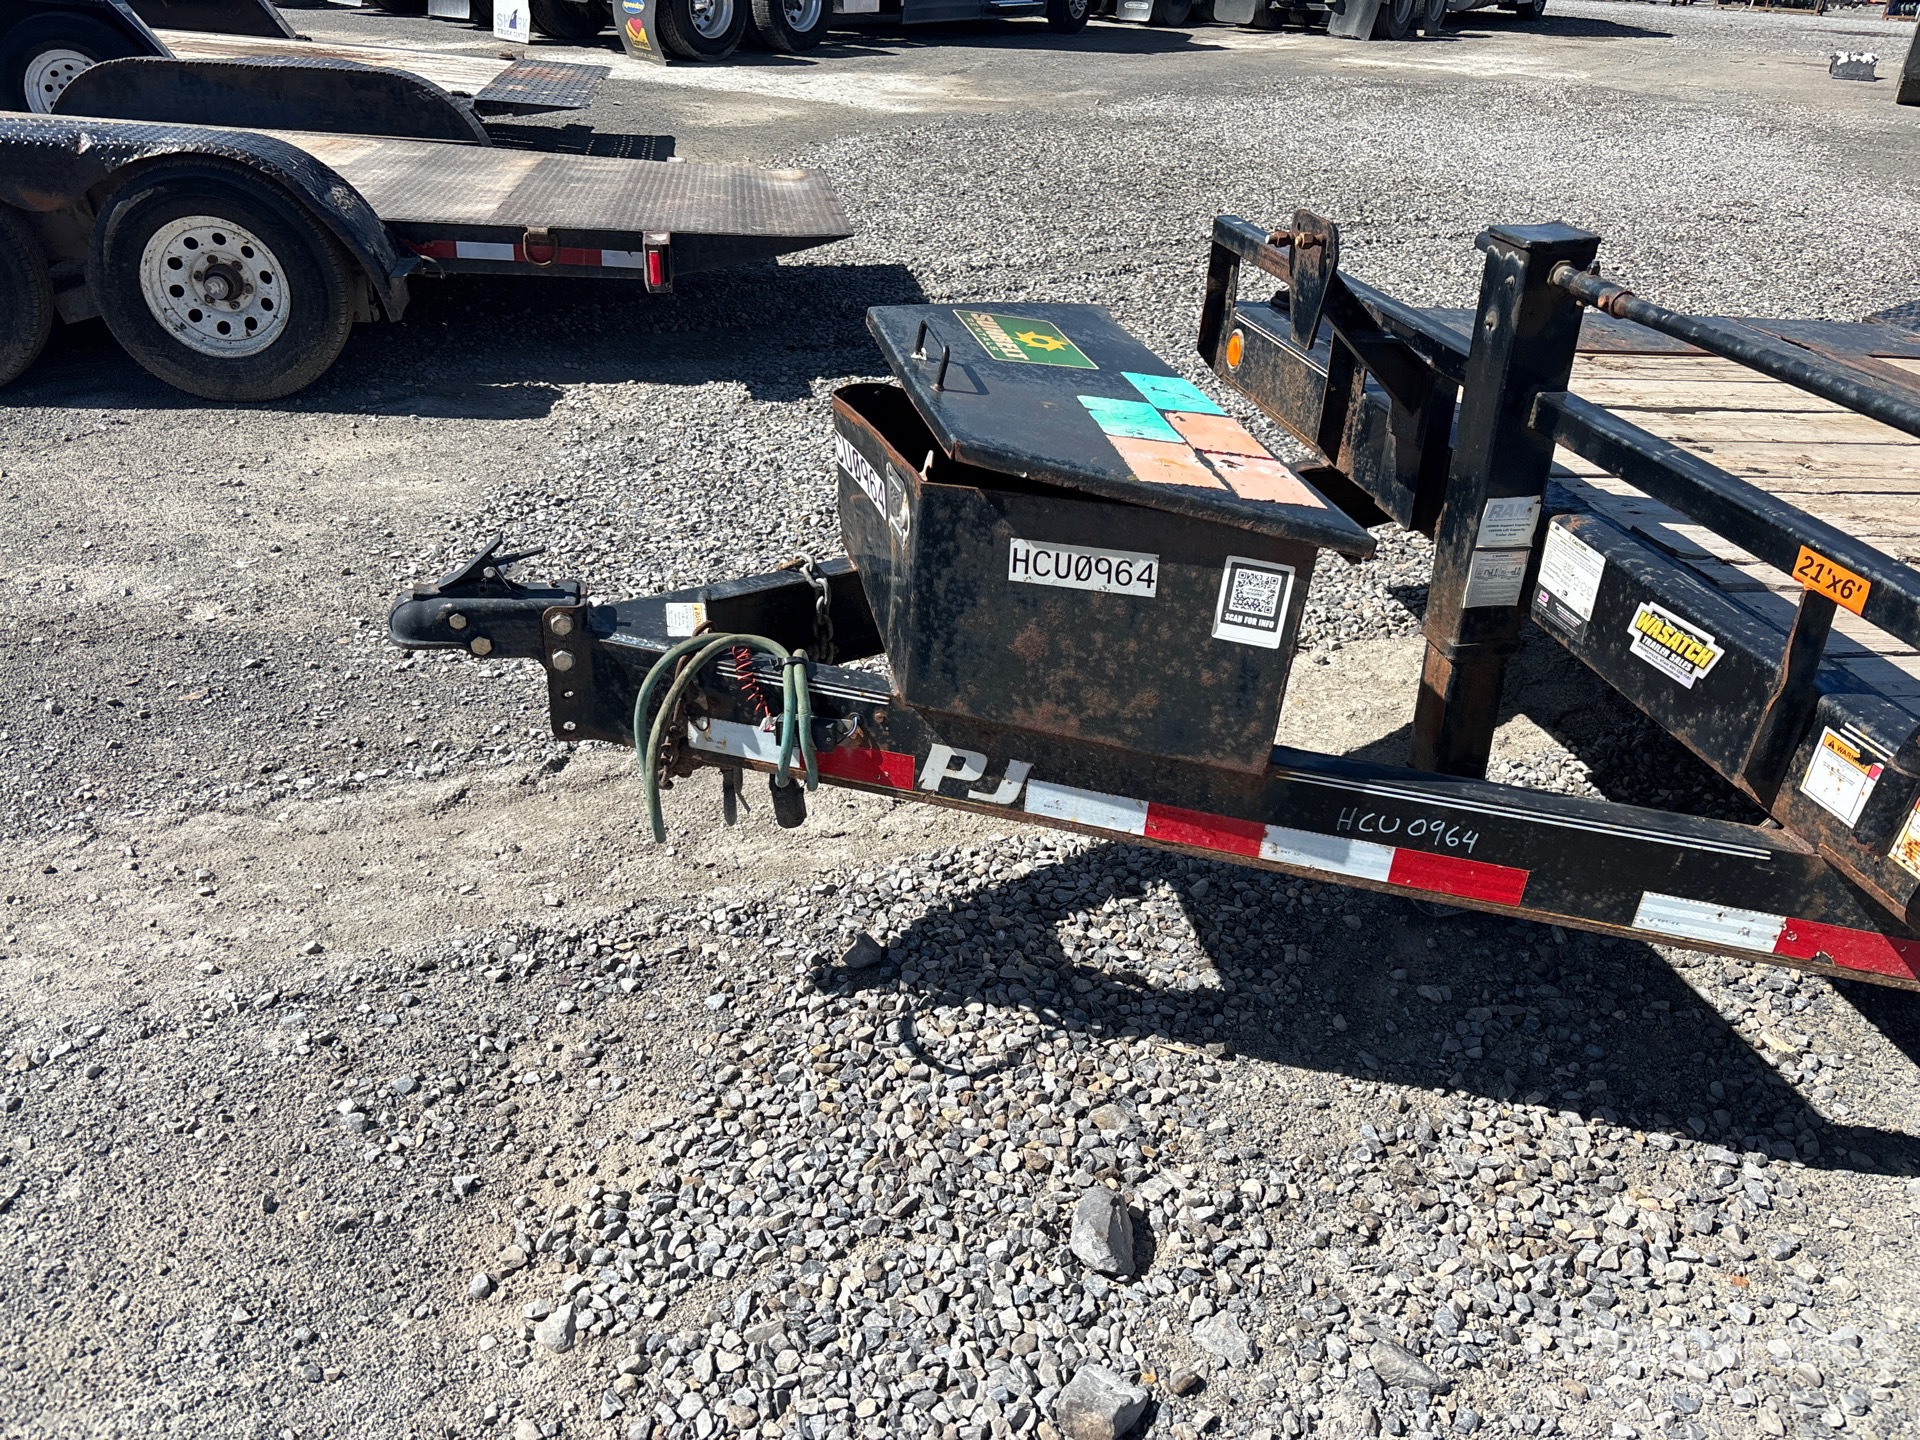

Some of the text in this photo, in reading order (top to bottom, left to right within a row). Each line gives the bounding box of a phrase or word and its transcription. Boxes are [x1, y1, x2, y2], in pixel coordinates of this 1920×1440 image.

[965, 317, 999, 352] RENTALS
[970, 313, 1030, 361] SUNBELT
[1012, 548, 1155, 589] HCU0964
[1798, 555, 1863, 599] 21'x6'
[1224, 613, 1275, 629] SCAN FOR INFO
[1635, 610, 1715, 670] WASATCH
[1641, 635, 1671, 658] TRAILER
[1669, 652, 1693, 671] SALES
[919, 743, 1034, 805] PJ
[1336, 807, 1479, 853] HCU 0964
